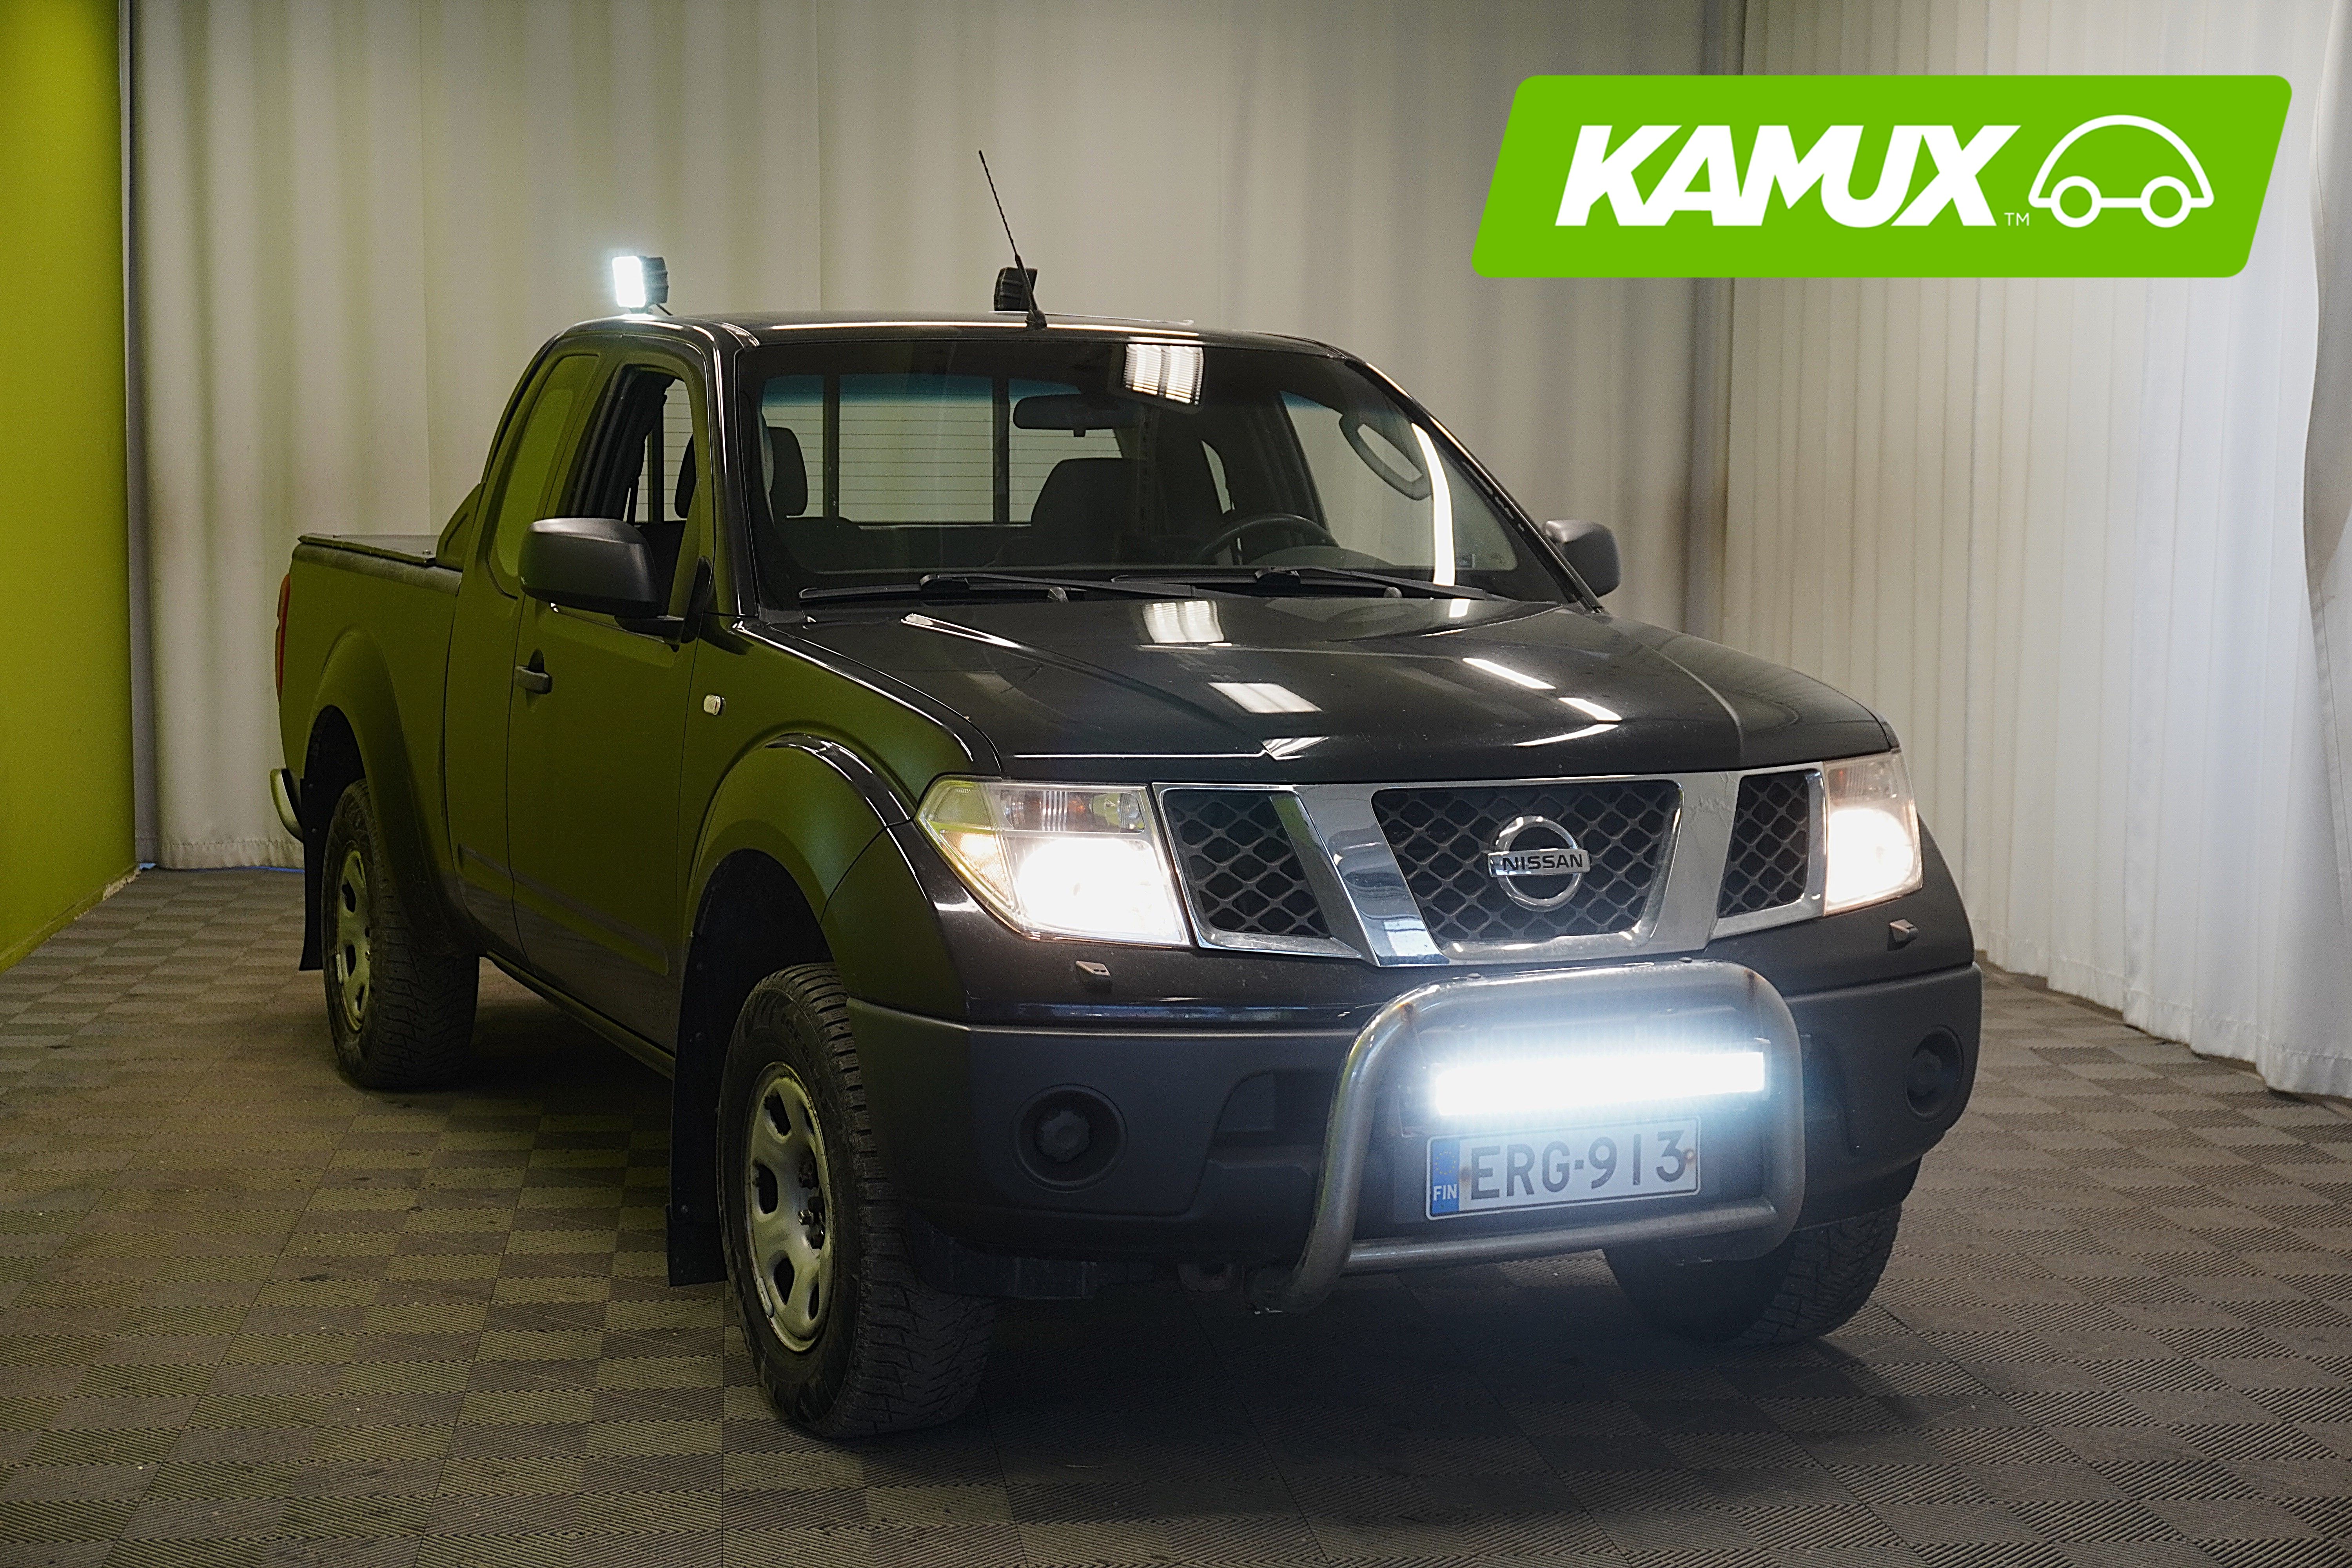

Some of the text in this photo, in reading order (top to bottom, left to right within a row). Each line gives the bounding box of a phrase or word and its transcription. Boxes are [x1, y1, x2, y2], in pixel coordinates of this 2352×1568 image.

[1503, 854, 1583, 870] NISSAN
[1471, 1129, 1686, 1200] ERG-913
[1433, 1183, 1458, 1201] FIN
